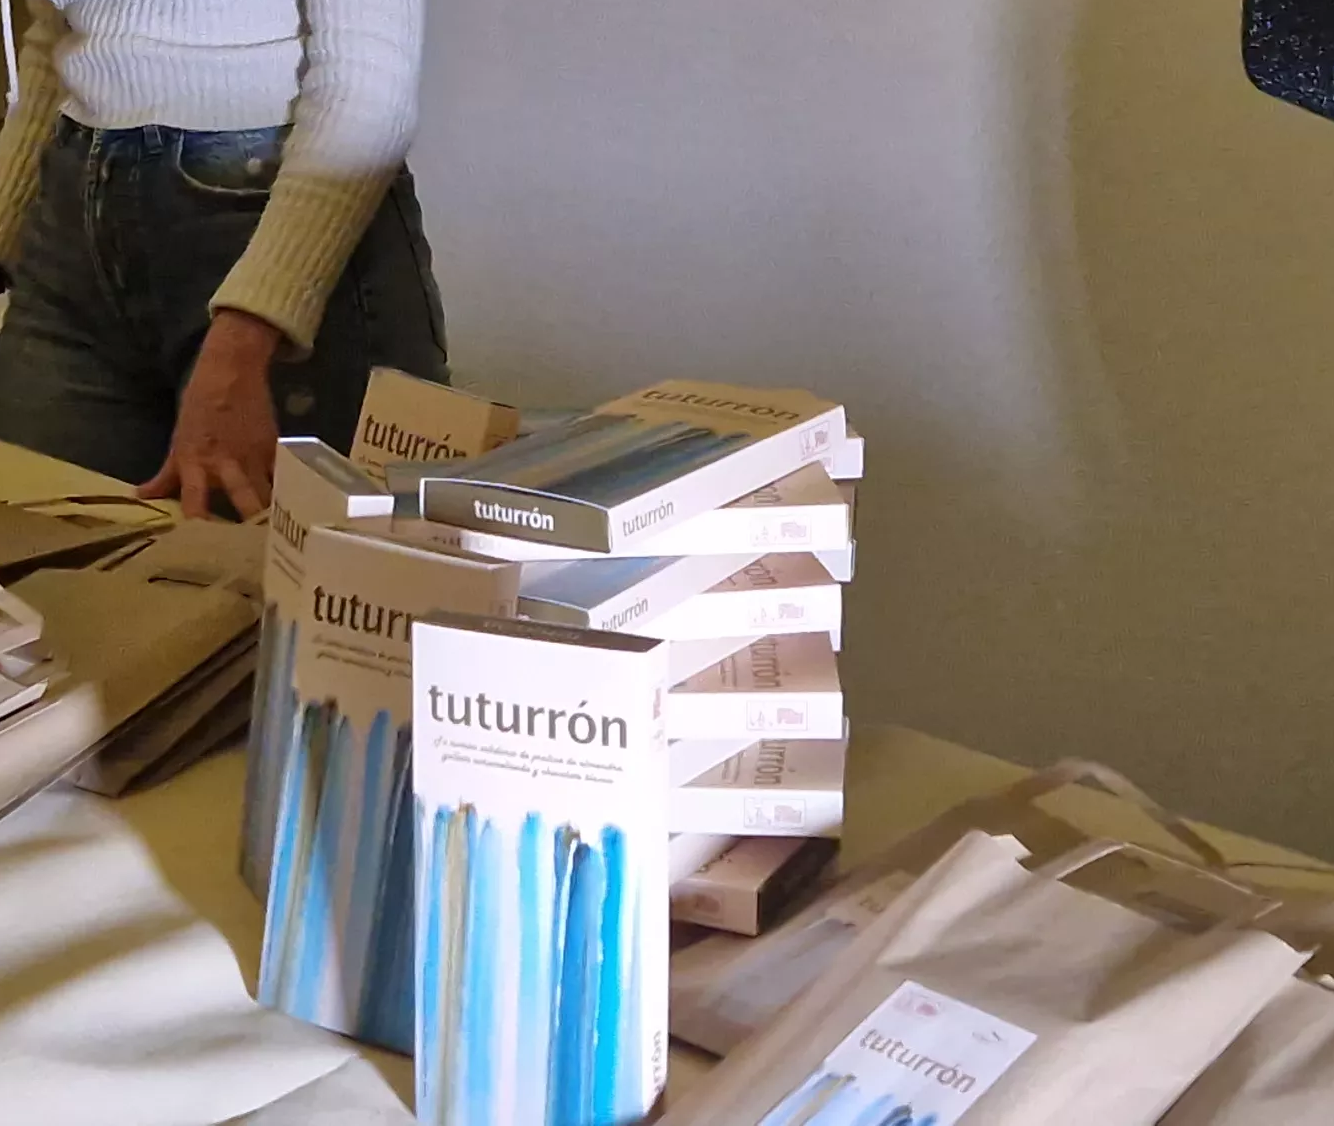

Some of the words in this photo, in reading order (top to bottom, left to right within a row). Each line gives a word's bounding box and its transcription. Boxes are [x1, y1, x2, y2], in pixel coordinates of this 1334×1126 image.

[640, 390, 800, 422] tuturrón
[473, 499, 555, 532] tuturrón
[622, 498, 675, 538] tuturrón
[428, 684, 628, 749] tuturrón
[859, 1028, 977, 1094] tuturrón
